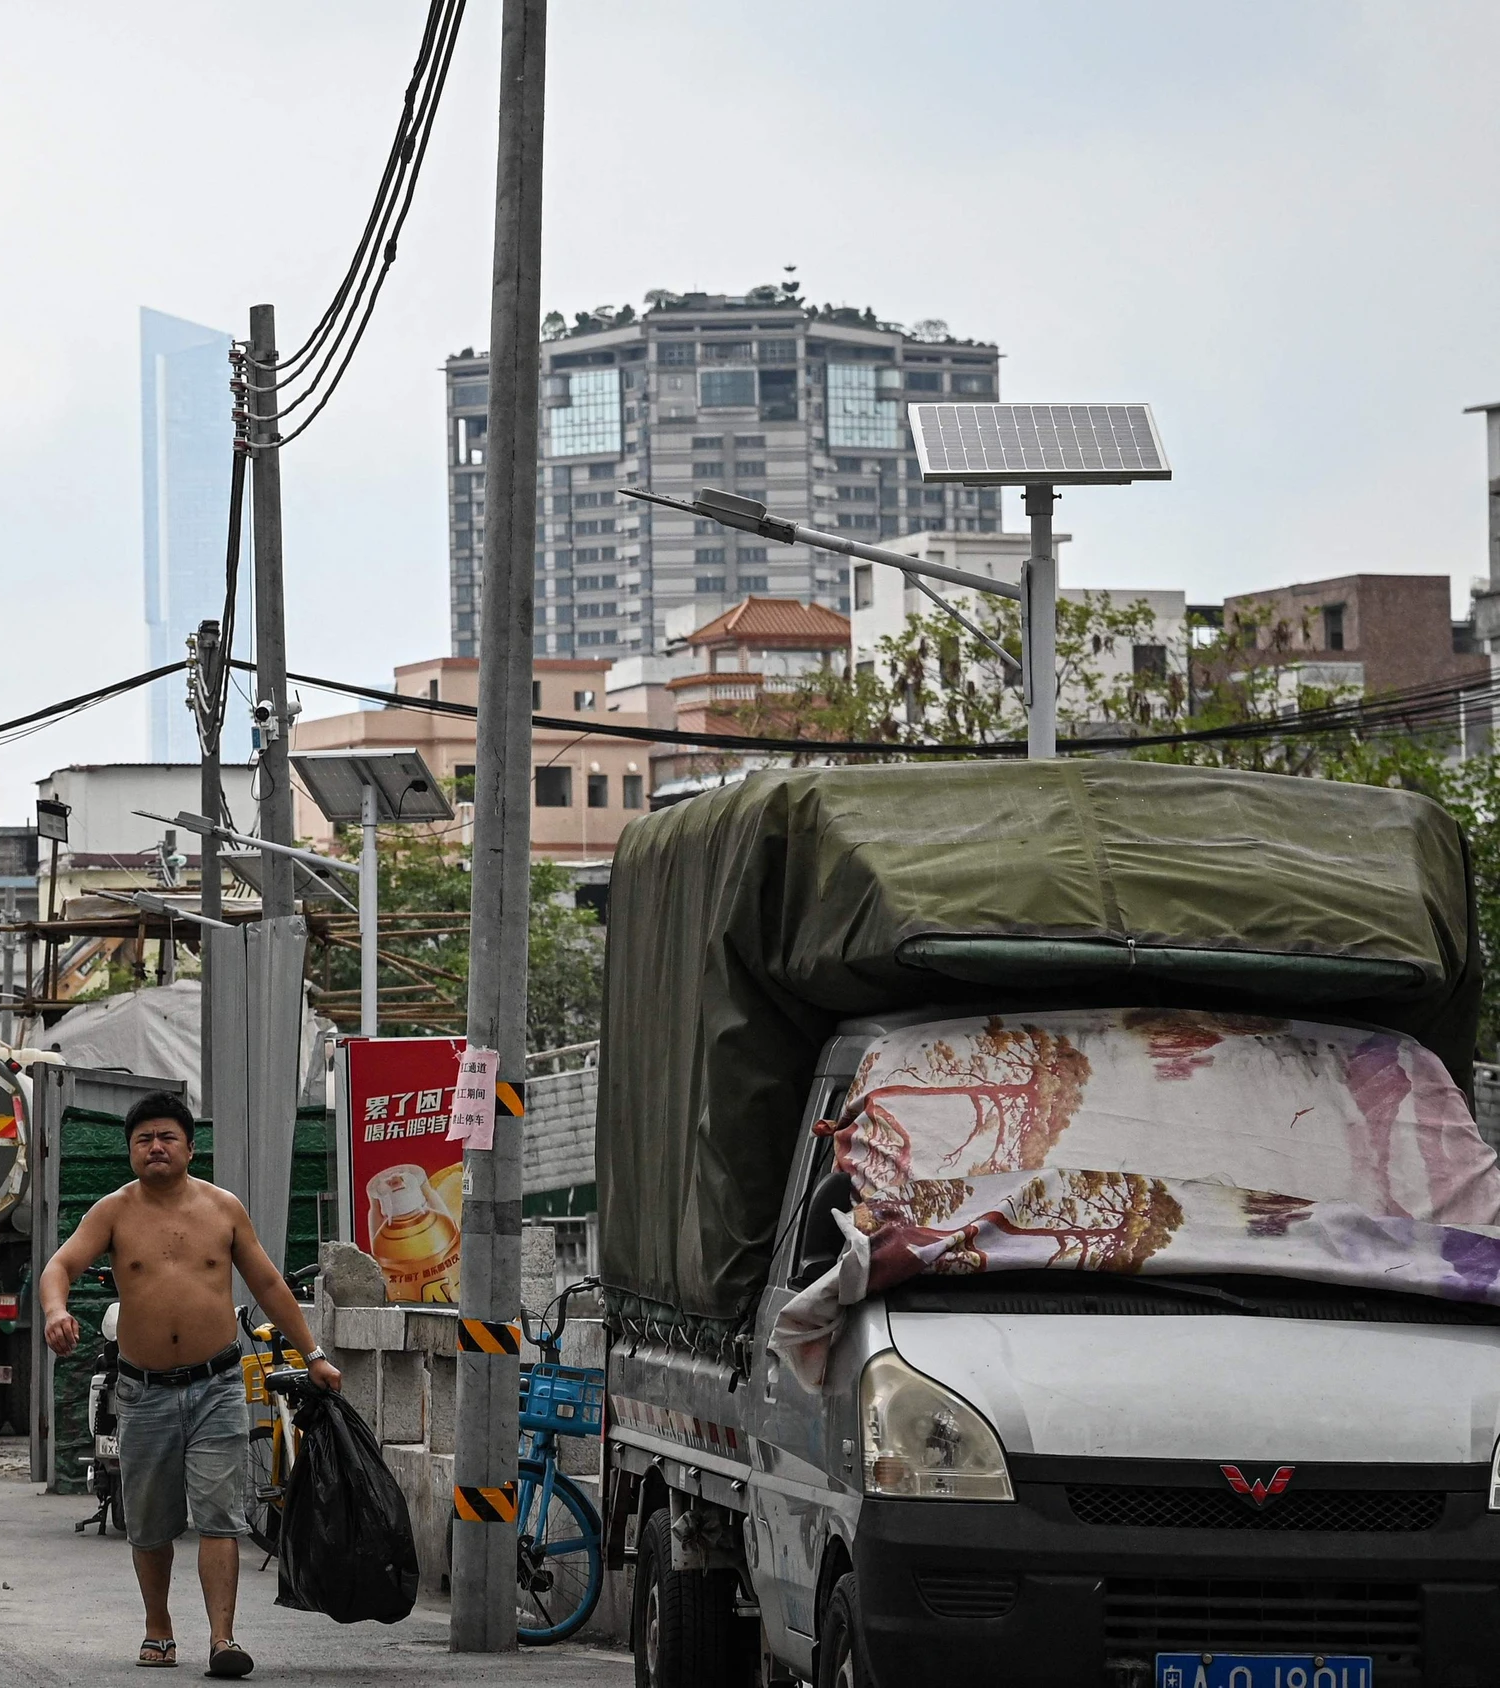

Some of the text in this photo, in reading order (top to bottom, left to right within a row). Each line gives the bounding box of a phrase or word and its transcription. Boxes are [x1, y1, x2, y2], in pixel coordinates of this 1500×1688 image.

[457, 1088, 486, 1100] 工期间
[452, 1113, 484, 1126] 止停车
[364, 1113, 455, 1142] 喝东鹏特
